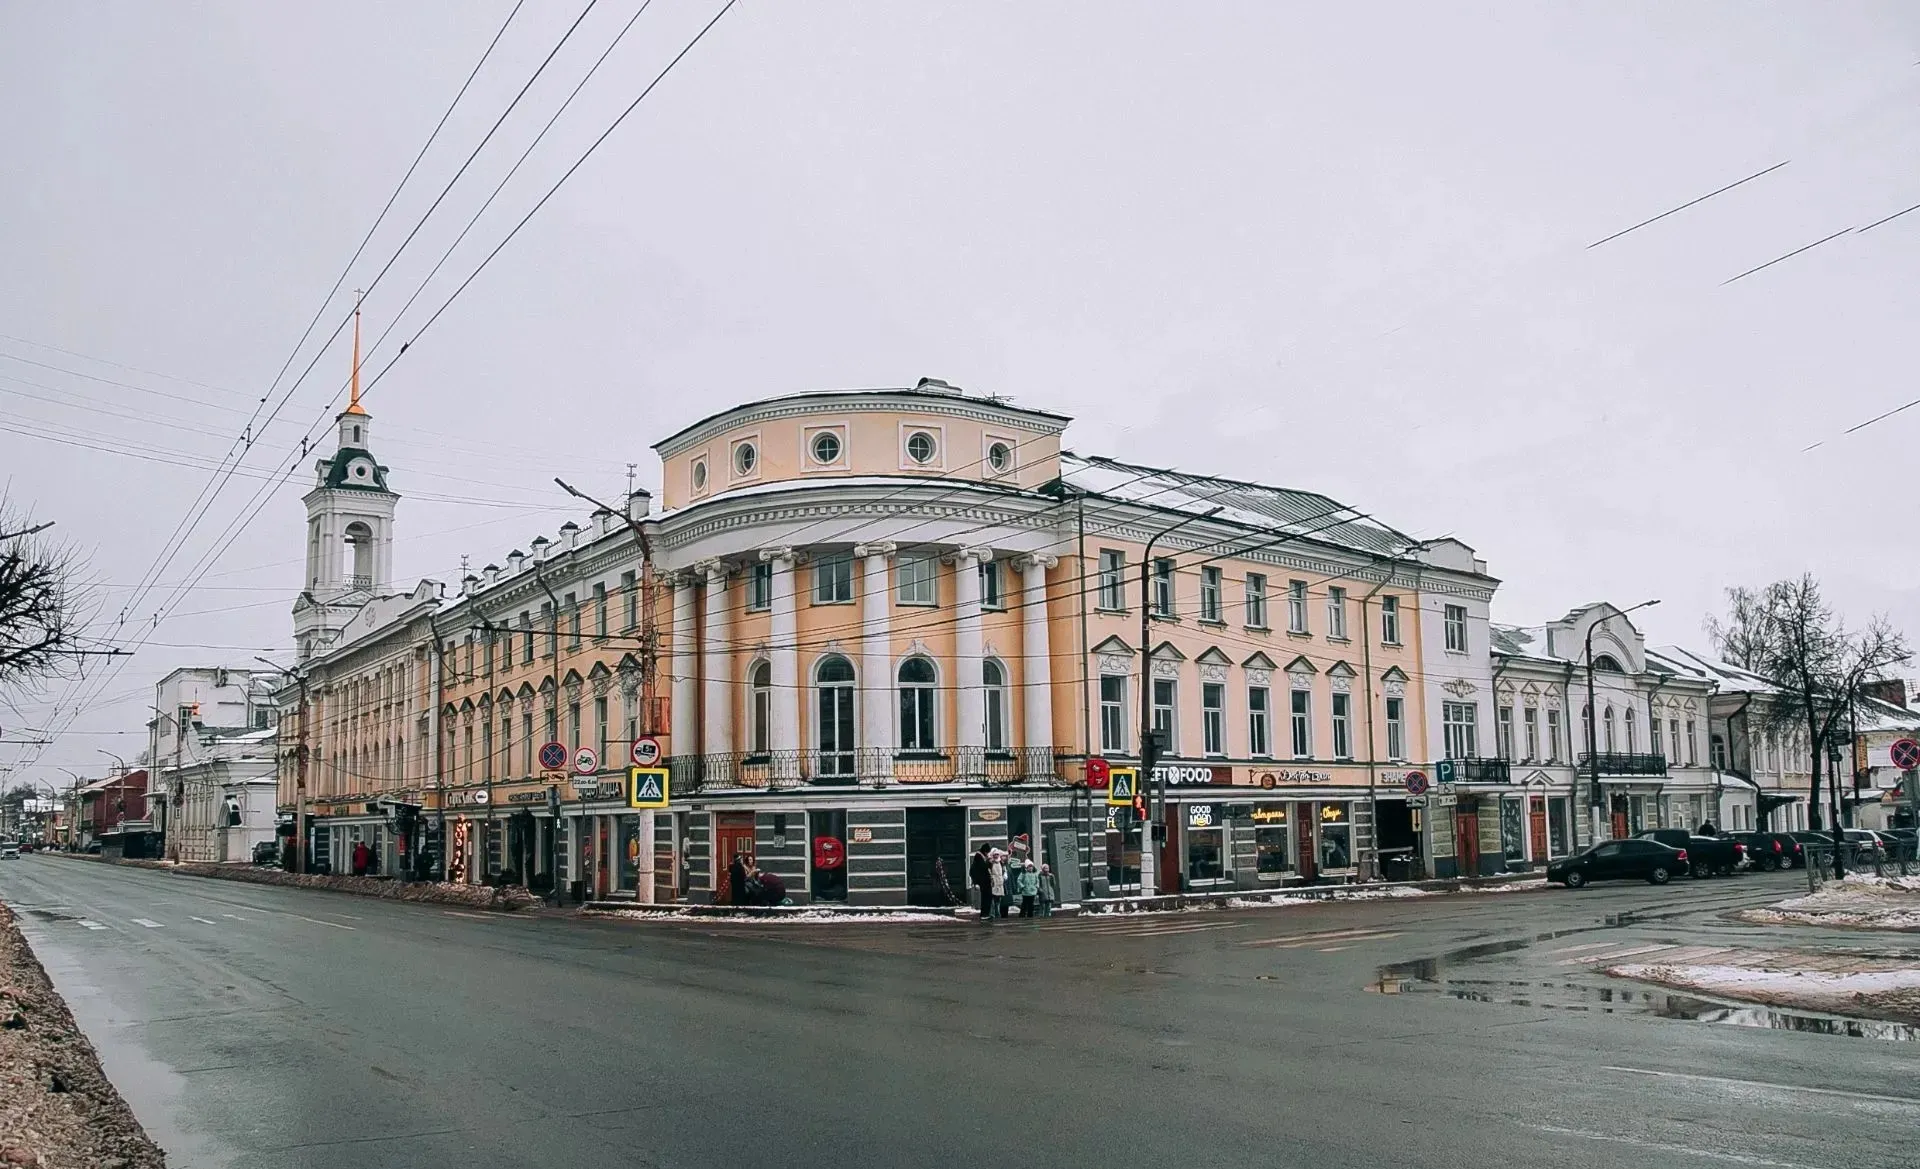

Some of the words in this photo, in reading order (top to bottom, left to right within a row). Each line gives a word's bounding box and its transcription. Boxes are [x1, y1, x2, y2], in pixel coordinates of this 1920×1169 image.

[1180, 767, 1212, 783] FOOD
[1381, 772, 1406, 783] ЗНАМЕ
[1190, 805, 1211, 815] GOOD
